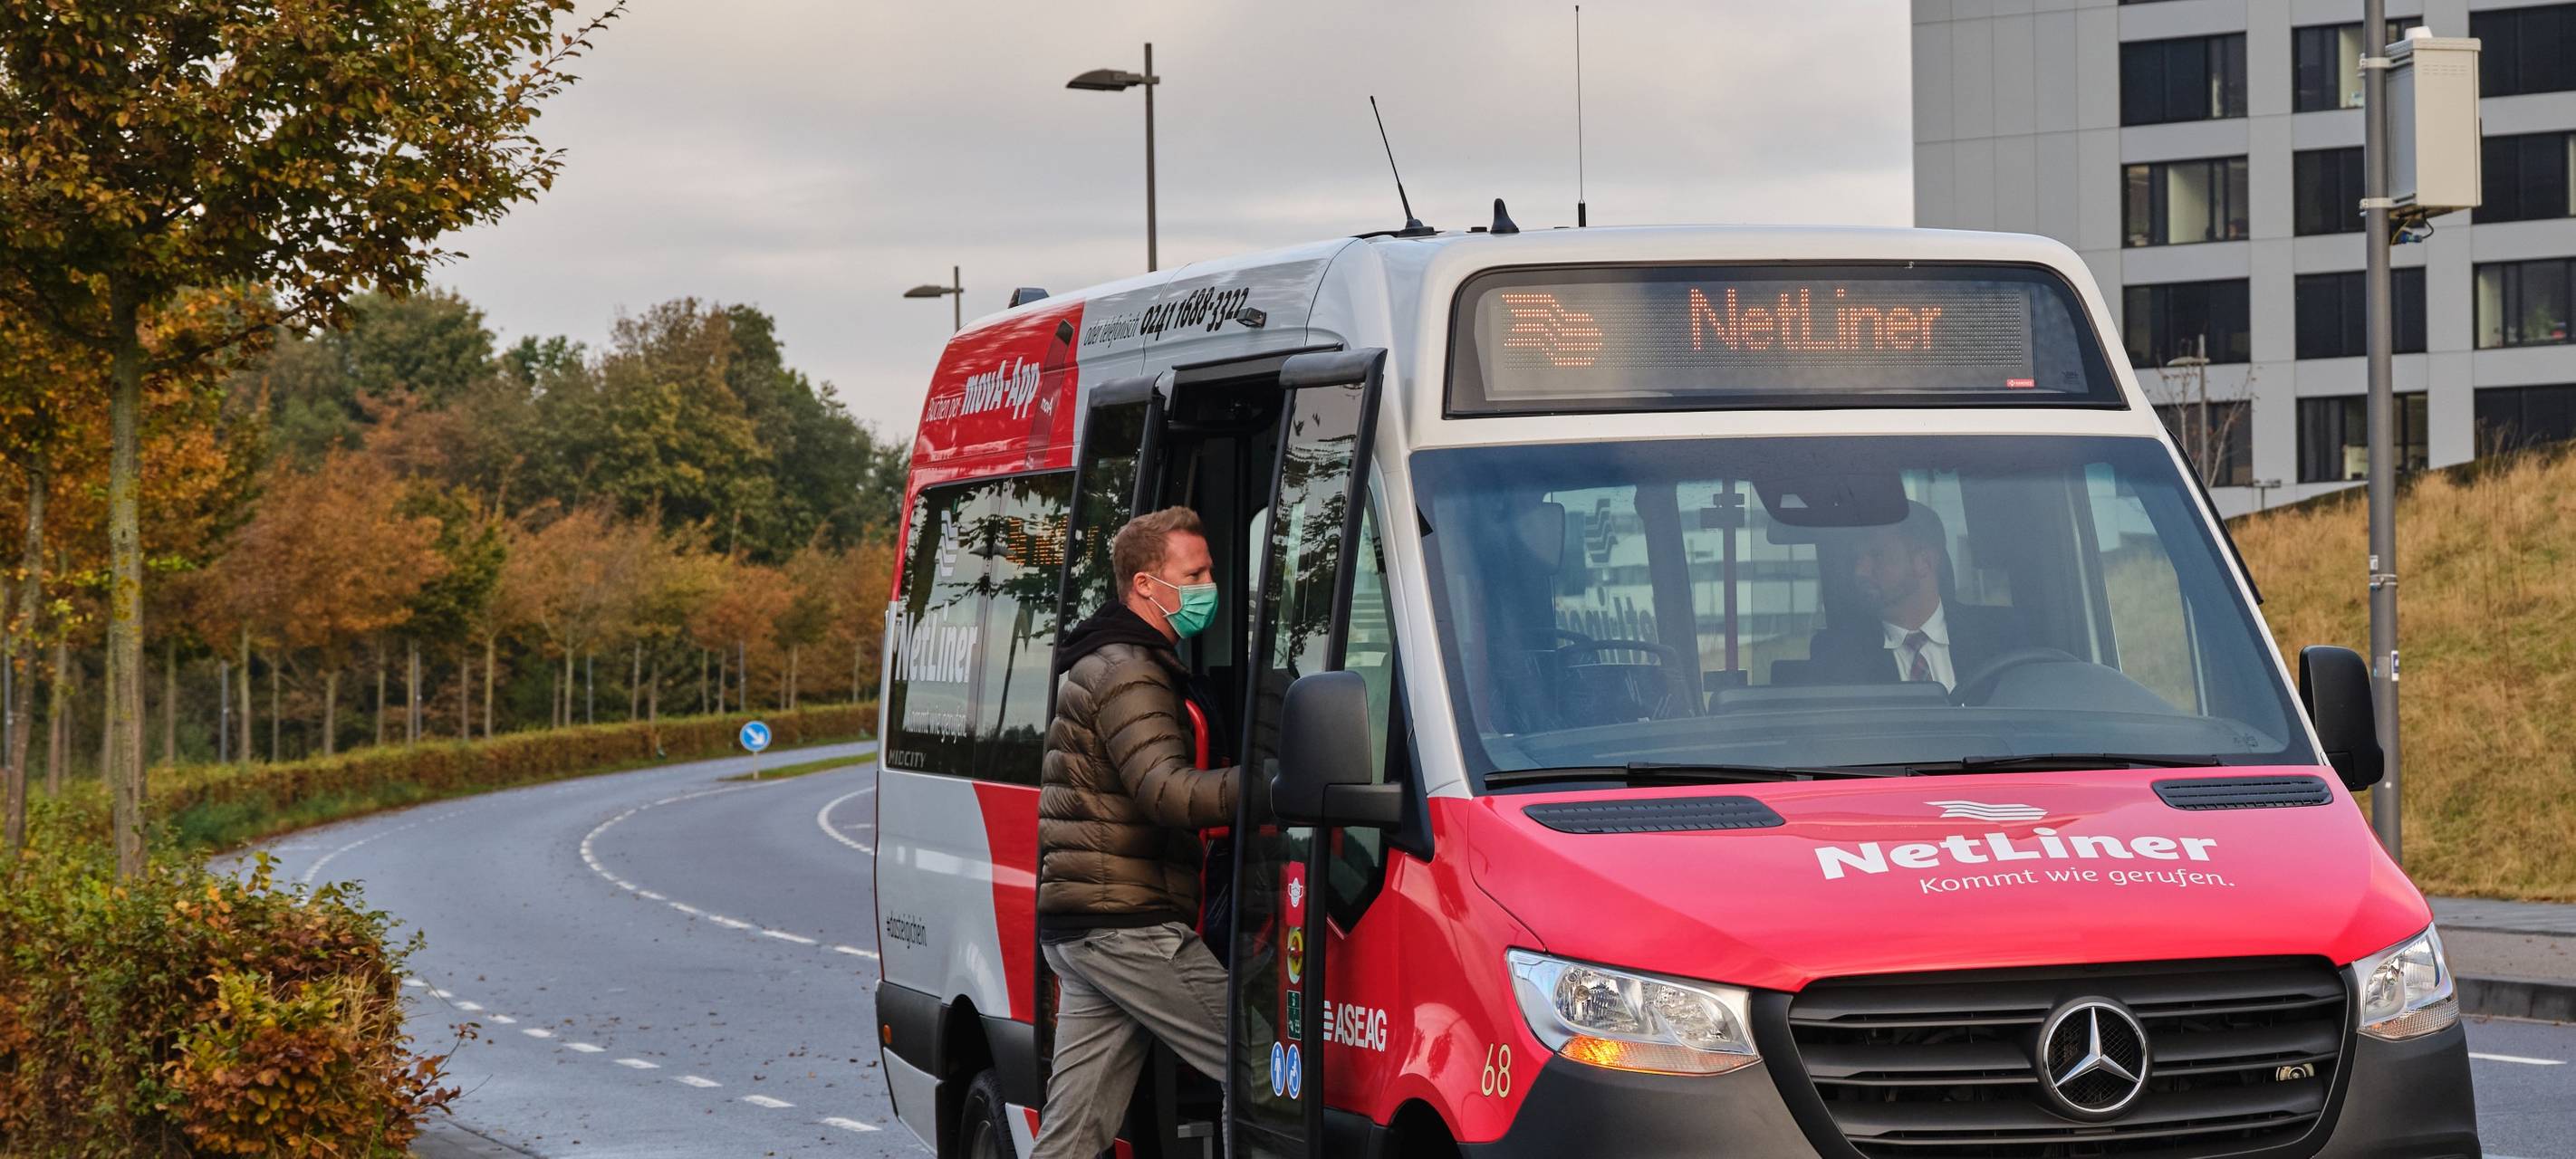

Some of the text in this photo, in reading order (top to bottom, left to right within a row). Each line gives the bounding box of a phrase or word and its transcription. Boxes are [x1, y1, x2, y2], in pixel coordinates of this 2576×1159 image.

[1139, 301, 1177, 341] 0241
[1174, 286, 1250, 332] 1688-3322
[1690, 288, 1943, 350] NetLiner
[960, 356, 1041, 420] movA-App
[895, 600, 978, 683] NetLiner
[888, 749, 927, 769] MIDCITY
[1814, 827, 2218, 880] NetLiner
[1919, 867, 2236, 895] Kommt wie gerufen.
[1334, 1002, 1388, 1052] ASEAG
[1481, 1043, 1512, 1098] 68
